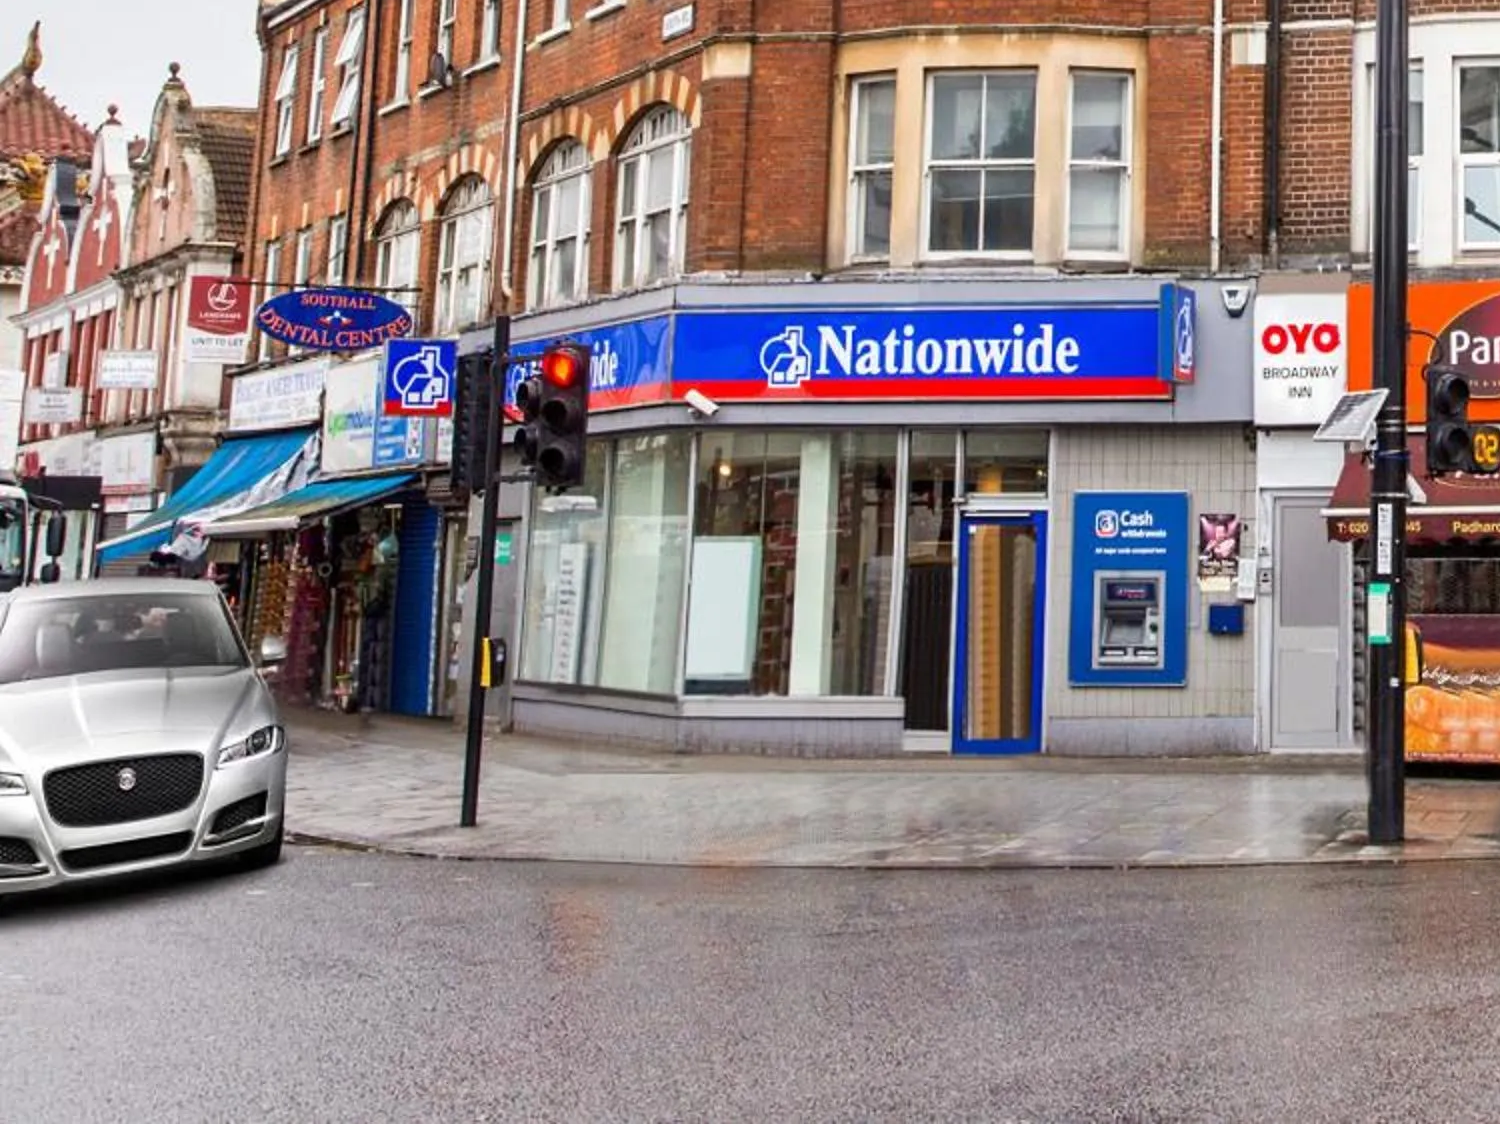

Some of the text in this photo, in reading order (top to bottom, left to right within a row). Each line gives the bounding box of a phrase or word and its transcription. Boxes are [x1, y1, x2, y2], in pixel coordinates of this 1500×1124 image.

[302, 293, 376, 309] SOUTHALL
[260, 308, 411, 347] DENTAL CENTRE
[1262, 323, 1341, 354] OYO
[816, 324, 1080, 375] Nationwide
[1263, 366, 1338, 379] BROADWAY
[1288, 386, 1312, 398] INN
[1120, 510, 1153, 526] Cash
[1350, 522, 1368, 533] 020
